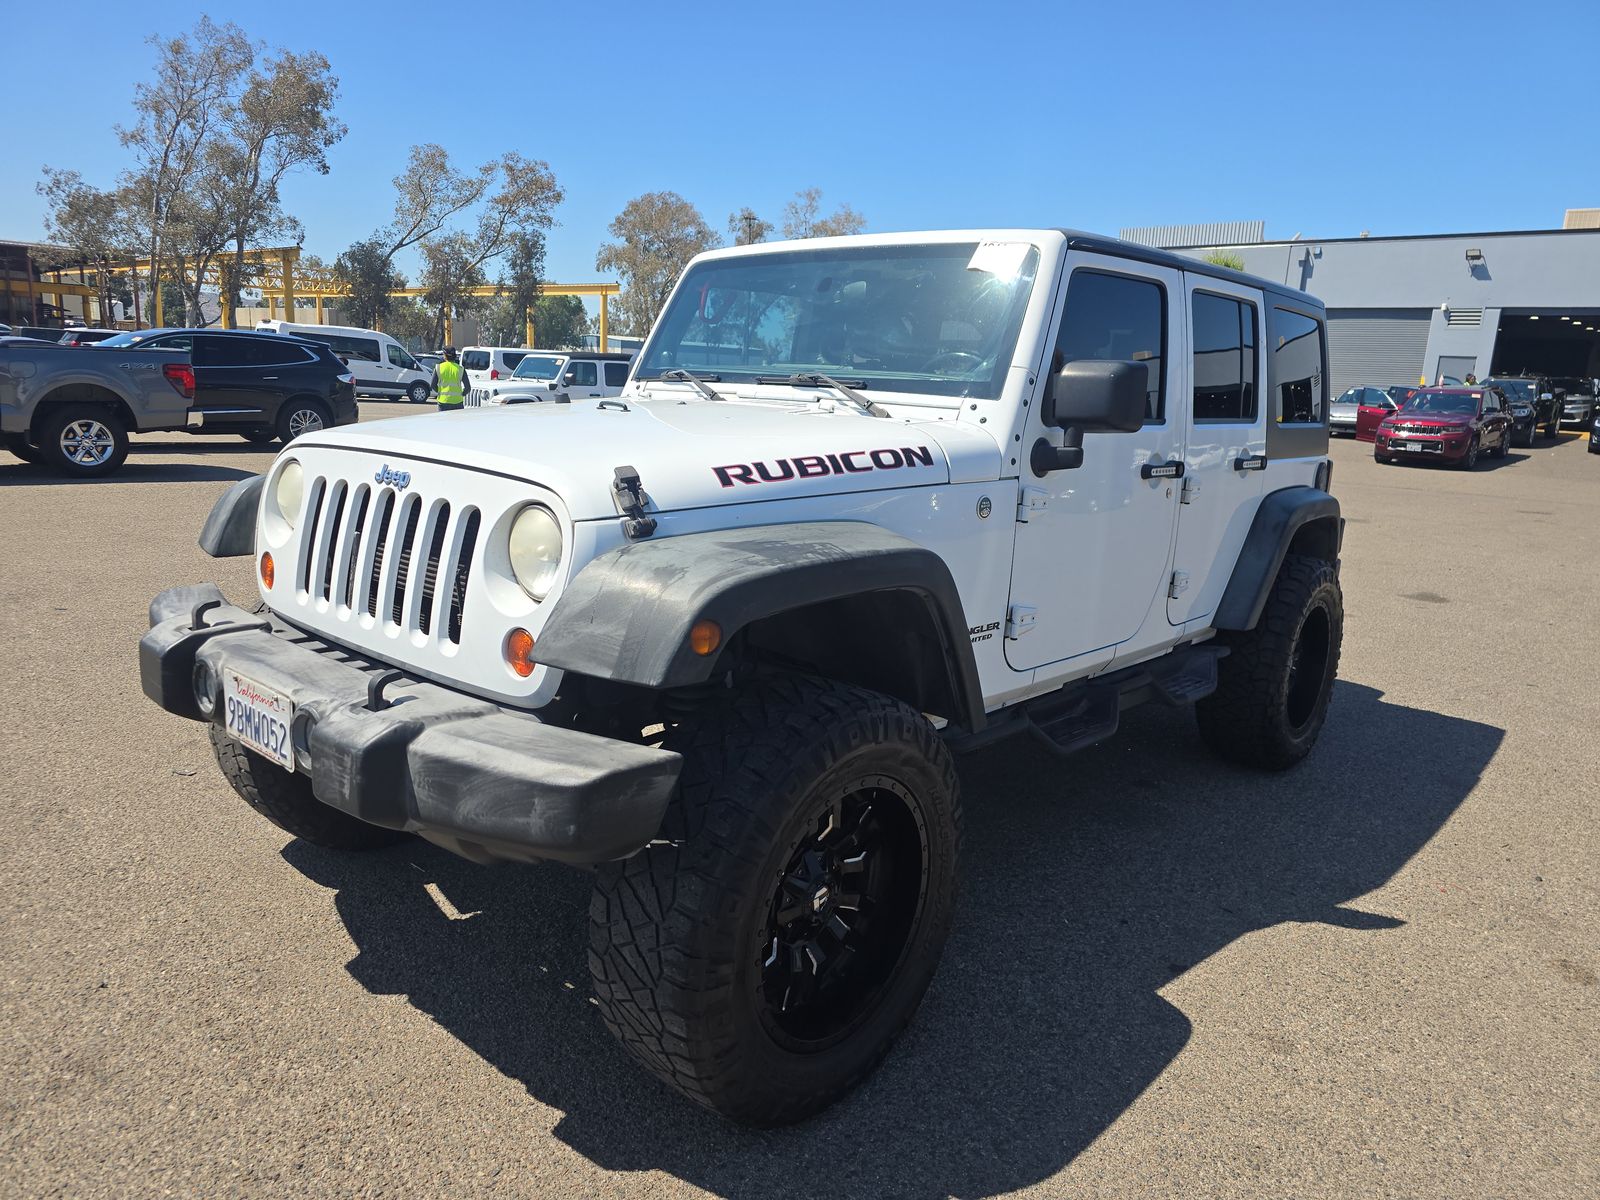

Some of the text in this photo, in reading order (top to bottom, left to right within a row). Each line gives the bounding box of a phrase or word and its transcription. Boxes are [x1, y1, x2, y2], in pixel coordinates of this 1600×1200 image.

[375, 463, 411, 492] Jeep
[711, 445, 935, 488] RUBICON
[235, 677, 277, 708] California
[228, 695, 288, 760] 9BMW052
